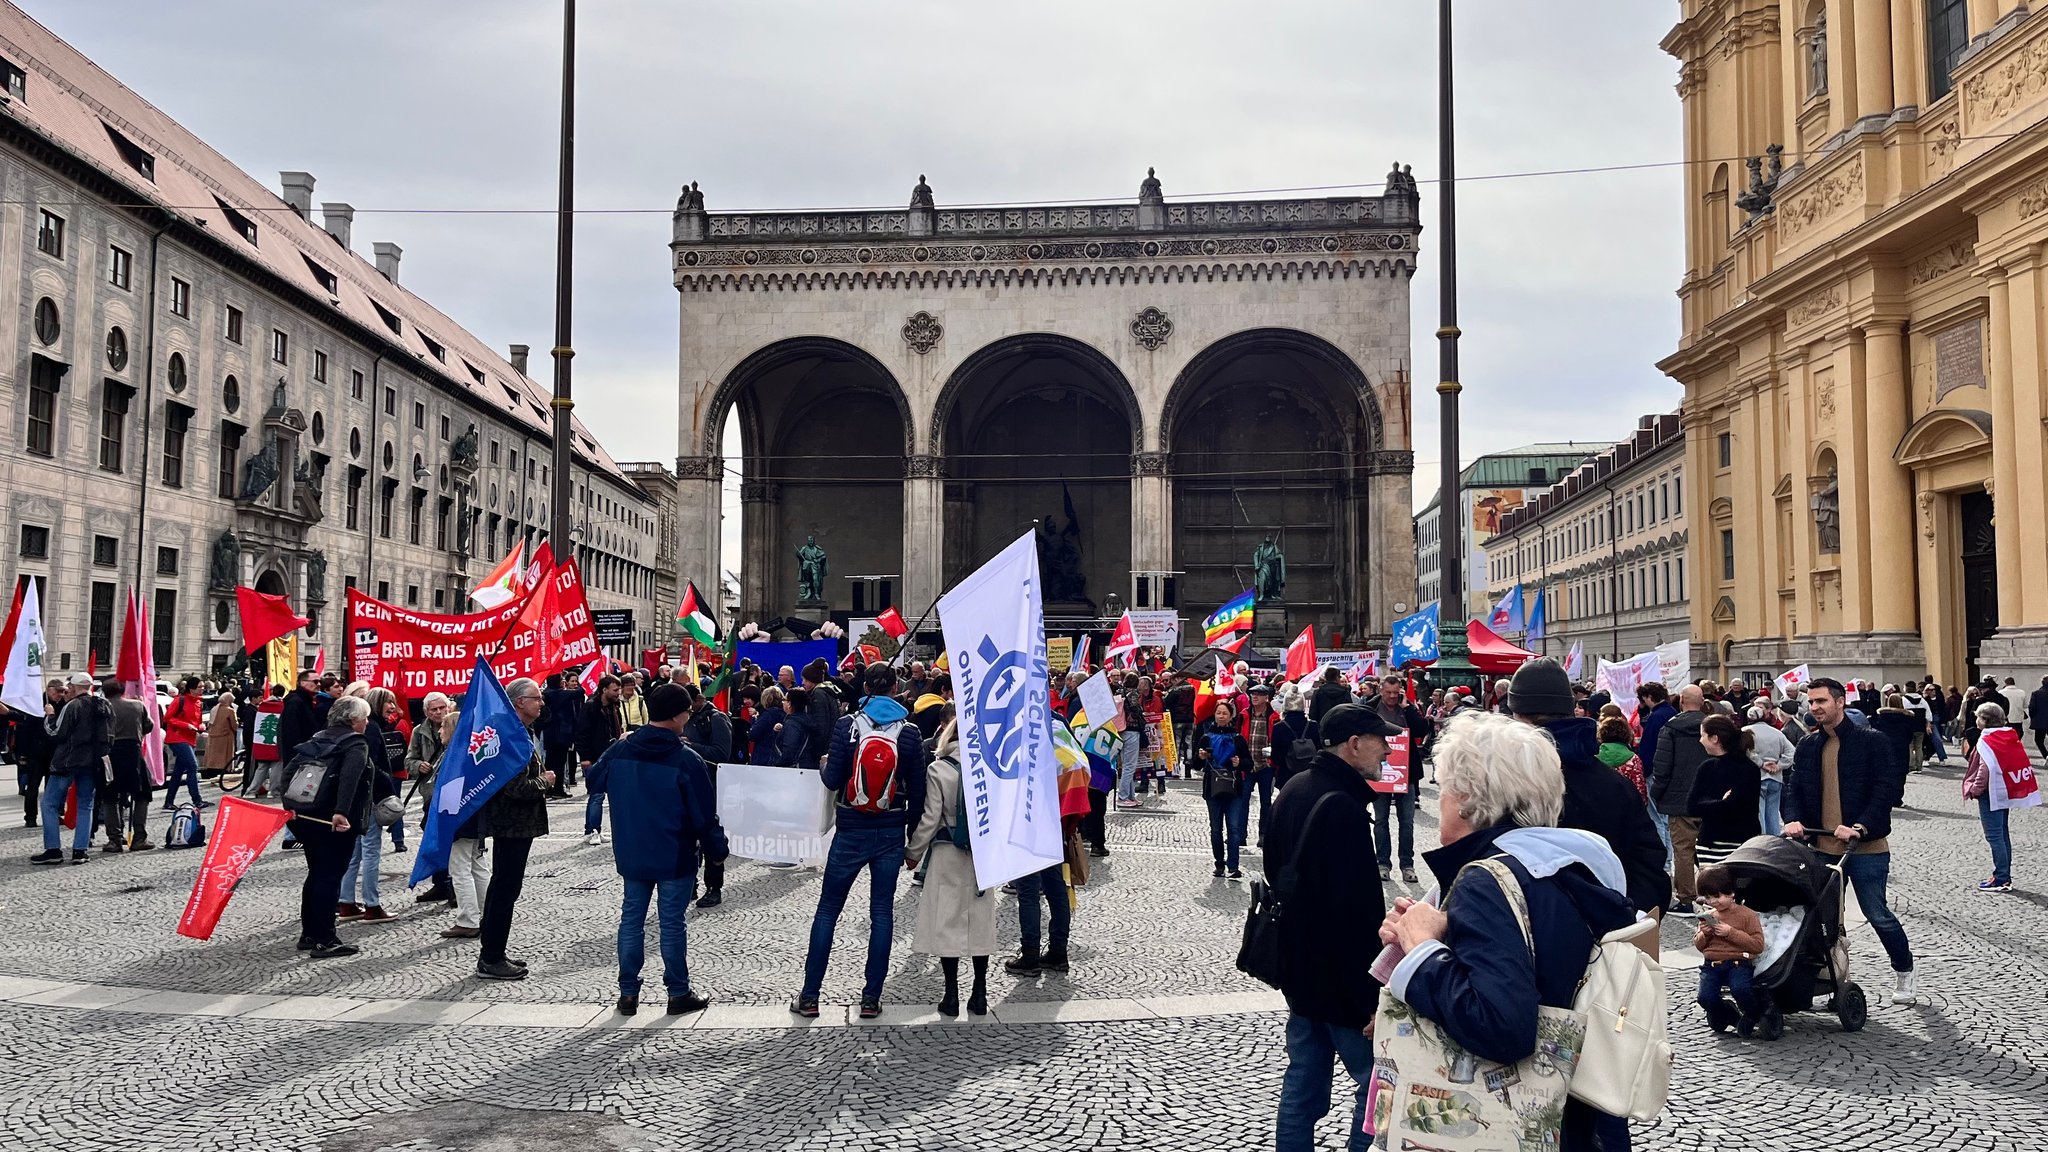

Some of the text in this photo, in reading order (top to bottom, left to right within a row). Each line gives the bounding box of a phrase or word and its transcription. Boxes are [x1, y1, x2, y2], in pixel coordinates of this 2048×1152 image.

[355, 601, 392, 621] KEIN
[470, 616, 497, 632] MIT
[556, 565, 577, 594] TO!
[382, 642, 413, 658] BRD
[421, 644, 467, 659] RAUS
[475, 643, 507, 659] AUS
[383, 670, 427, 688] NTO
[562, 631, 597, 662] BRD!
[958, 650, 990, 837] OHNE WAFFEN!
[1517, 1084, 1549, 1099] Floral
